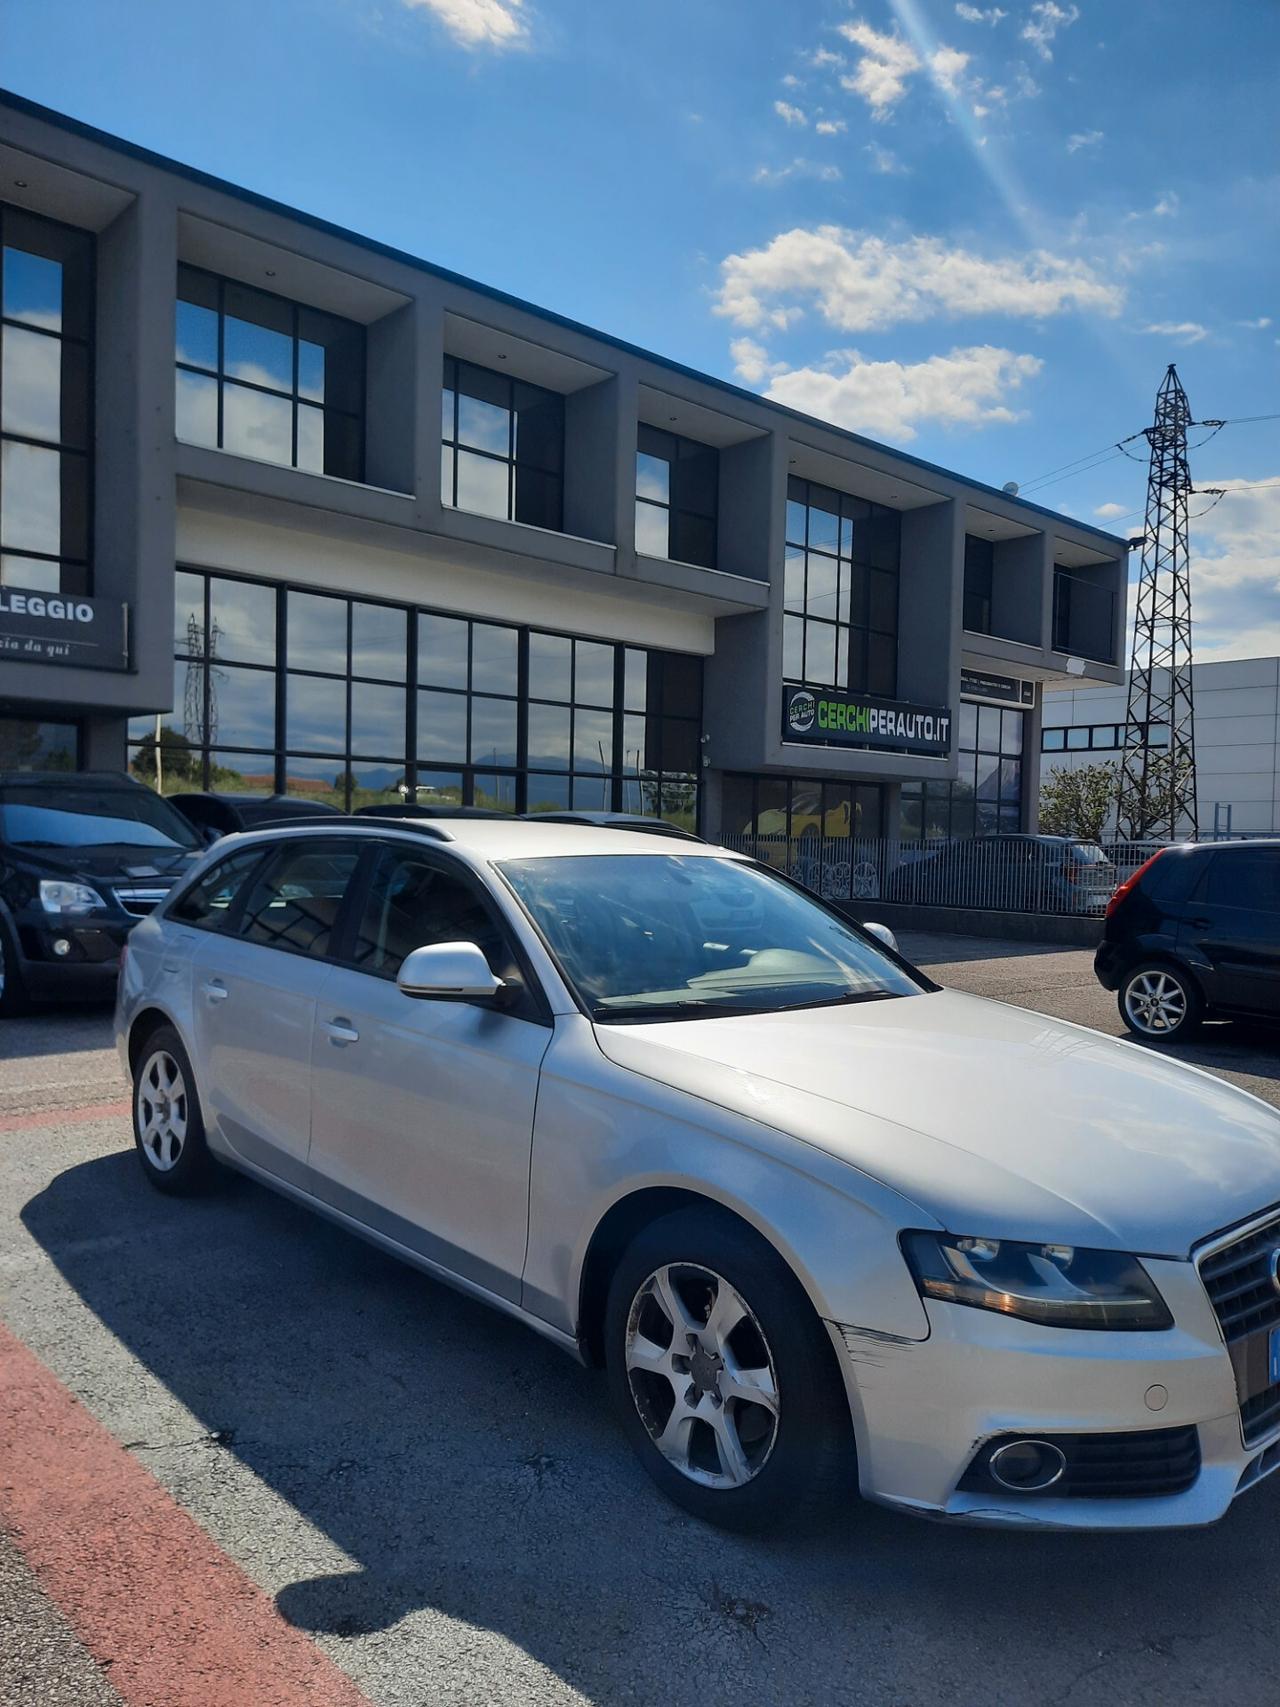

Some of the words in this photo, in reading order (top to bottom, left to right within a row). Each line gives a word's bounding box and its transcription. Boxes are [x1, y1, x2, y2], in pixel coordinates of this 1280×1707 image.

[24, 639, 42, 652] da
[46, 644, 70, 657] qui
[789, 701, 815, 715] CERCHI
[801, 709, 815, 718] AUTO
[818, 700, 949, 742] CERCHIPERAUTO.IT
